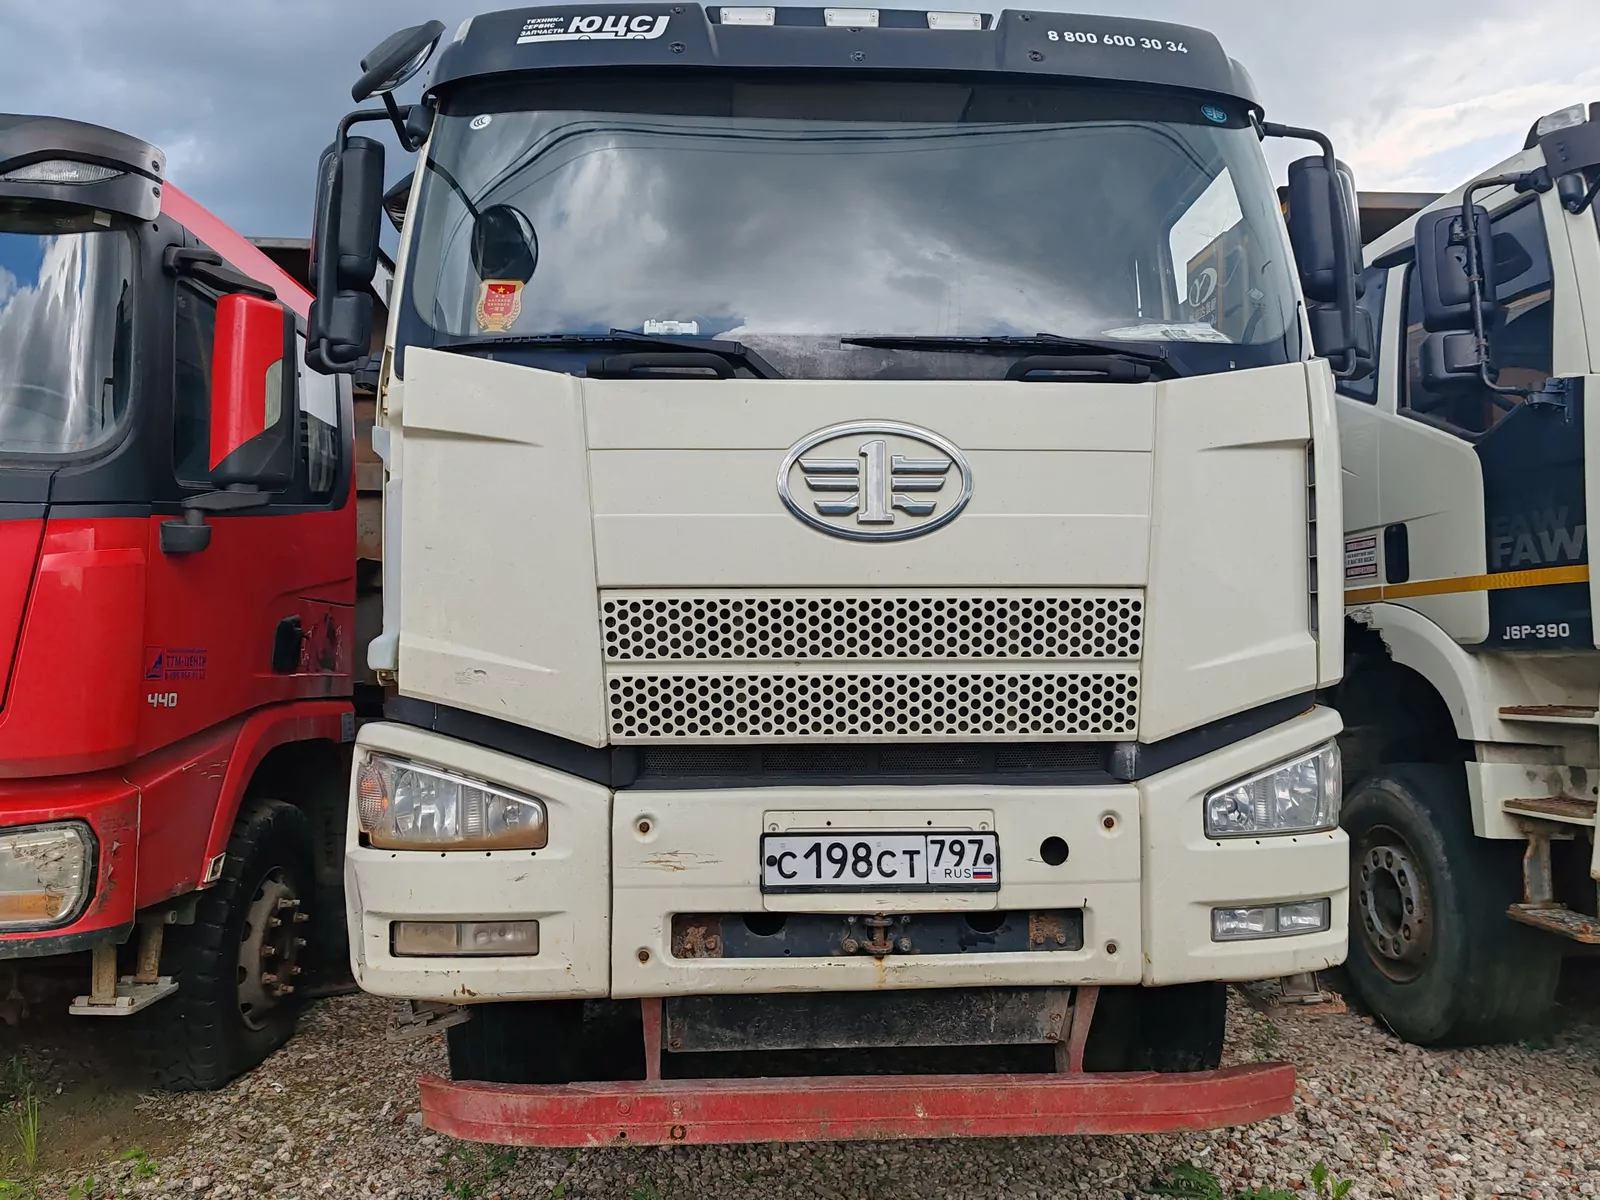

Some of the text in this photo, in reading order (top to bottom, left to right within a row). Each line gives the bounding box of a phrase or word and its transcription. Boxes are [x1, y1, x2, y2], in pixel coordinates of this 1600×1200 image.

[522, 22, 556, 30] СЕРВИС
[526, 16, 564, 24] ТЕХНИКА
[520, 28, 565, 36] ЗАПЧАСТИ
[1047, 30, 1188, 53] 8 800 600 30 34
[1492, 525, 1586, 569] FAW
[1502, 622, 1570, 640] J6P-390
[147, 692, 178, 708] 440
[930, 839, 984, 867] 797
[944, 868, 972, 879] RUS
